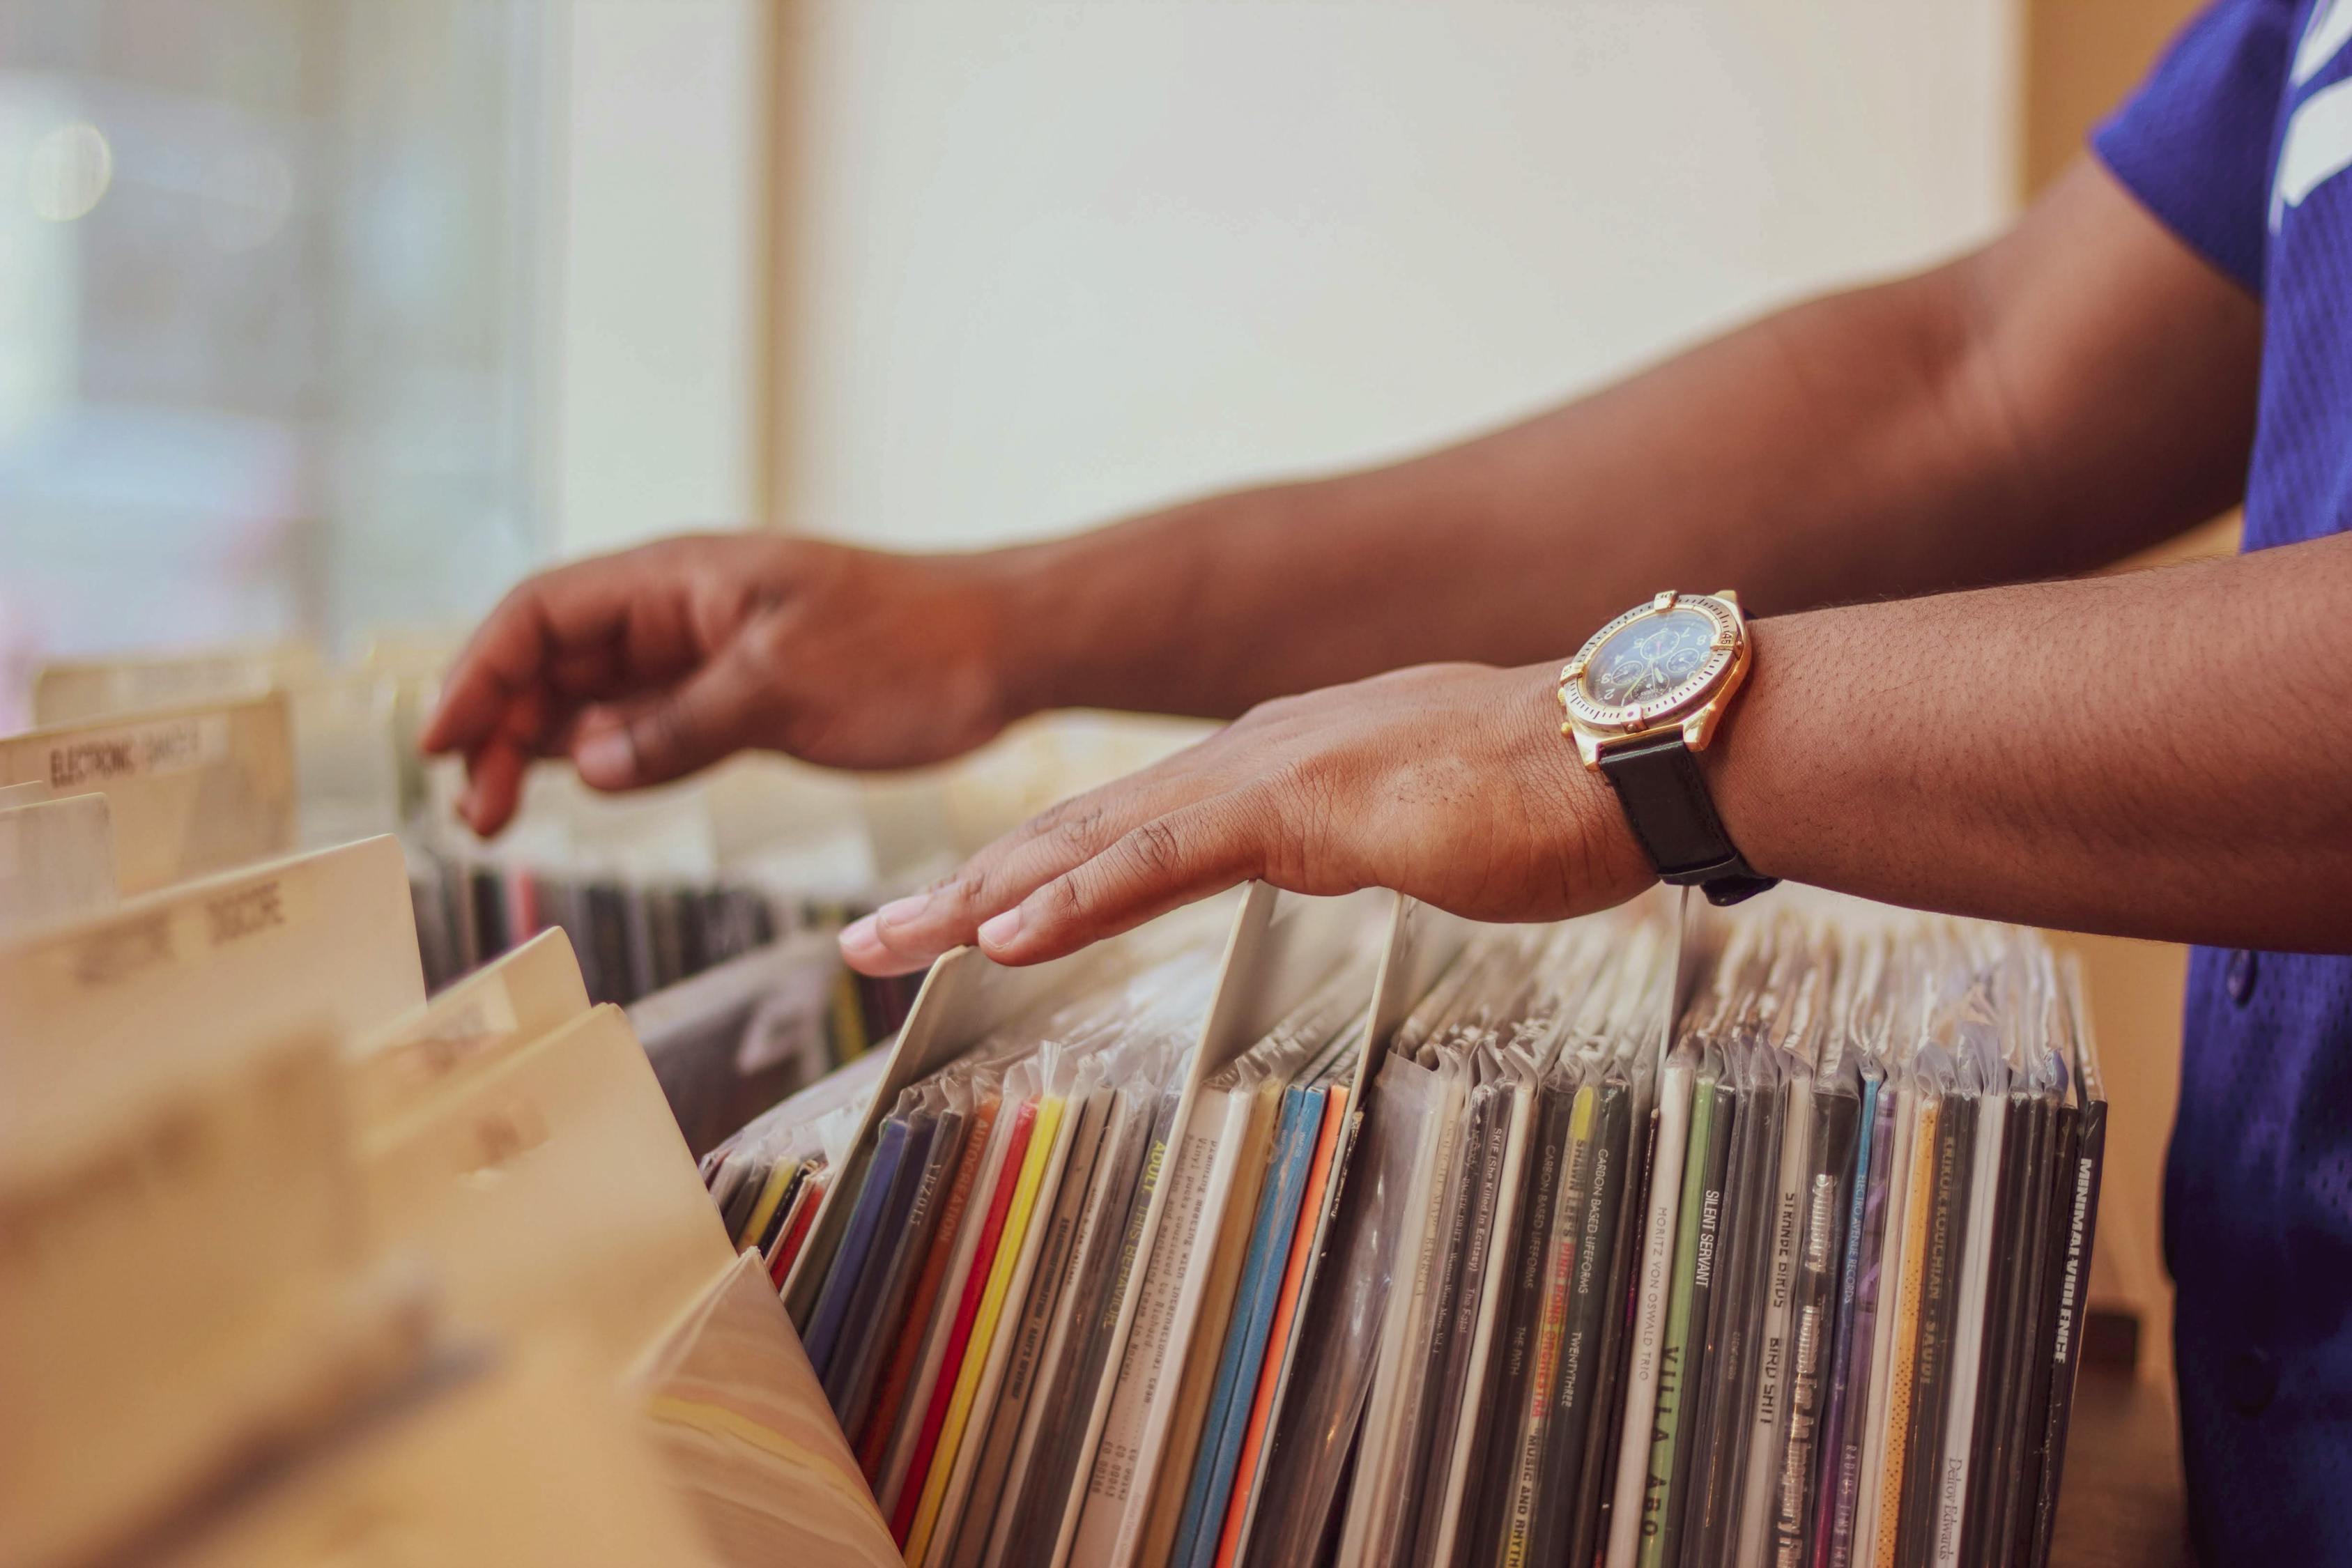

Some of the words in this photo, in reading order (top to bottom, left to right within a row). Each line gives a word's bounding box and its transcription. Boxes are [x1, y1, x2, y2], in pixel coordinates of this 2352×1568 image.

[1696, 635, 1707, 645] 8
[1721, 633, 1732, 645] 45
[1604, 688, 1615, 700] 2
[1189, 1136, 1208, 1170] Vinyl
[1489, 1127, 1502, 1153] SKIE
[937, 1116, 990, 1243] AUTOCREATION
[1484, 1155, 1497, 1179] (She
[1539, 1144, 1555, 1192] CARBON
[1568, 1139, 1590, 1192] SHAWN
[1592, 1148, 1608, 1197] CARBON
[1178, 1176, 1196, 1210] pucks
[1457, 1176, 1470, 1211] PACIFIC
[1479, 1181, 1493, 1211] Killed
[1532, 1193, 1547, 1229] BASED
[1701, 1189, 1719, 1232] SILENT
[1853, 1174, 1867, 1215] ELECTRO
[2068, 1158, 2091, 1256] MINIMAL
[1128, 1202, 1150, 1241] THIS
[1183, 1198, 1203, 1246] meeting
[1452, 1214, 1464, 1243] DRIFT
[1477, 1214, 1487, 1224] In
[1561, 1195, 1581, 1238] LEE'S
[1586, 1197, 1601, 1233] BASED
[1652, 1206, 1667, 1256] MORITZ
[1162, 1214, 1185, 1276] couriered
[1467, 1227, 1485, 1272] Ecstasy)
[1848, 1217, 1861, 1256] AVENUE
[1523, 1231, 1542, 1289] LIFEFORMS
[1555, 1240, 1574, 1279] PING
[1577, 1235, 1596, 1294] LIFEFORMS
[1648, 1260, 1661, 1289] VON
[1694, 1233, 1714, 1288] SERVANT
[1103, 1243, 1139, 1328] BEHAVIOR
[1157, 1281, 1169, 1296] to
[1463, 1286, 1475, 1305] The
[1773, 1261, 1788, 1308] BIRDS
[1843, 1259, 1857, 1305] RECORDS
[1133, 1324, 1143, 1337] in
[1643, 1292, 1657, 1346] OSWALD
[2053, 1256, 2078, 1364] VIOLENCE
[1514, 1325, 1525, 1347] THE
[1509, 1348, 1522, 1376] PATH
[1530, 1329, 1558, 1418] ORCHESTRA
[1561, 1330, 1581, 1408] TWENTYTHREE
[1638, 1351, 1651, 1381] TRIO
[1765, 1337, 1780, 1378] BIRD
[1651, 1344, 1679, 1444] VILLA
[1759, 1383, 1775, 1425] SHIT
[1840, 1444, 1857, 1495] RADIUS
[1944, 1457, 1962, 1501] Delroy
[1516, 1484, 1532, 1515] AND
[1640, 1473, 1667, 1537] ABO
[1938, 1504, 1958, 1561] Edwards
